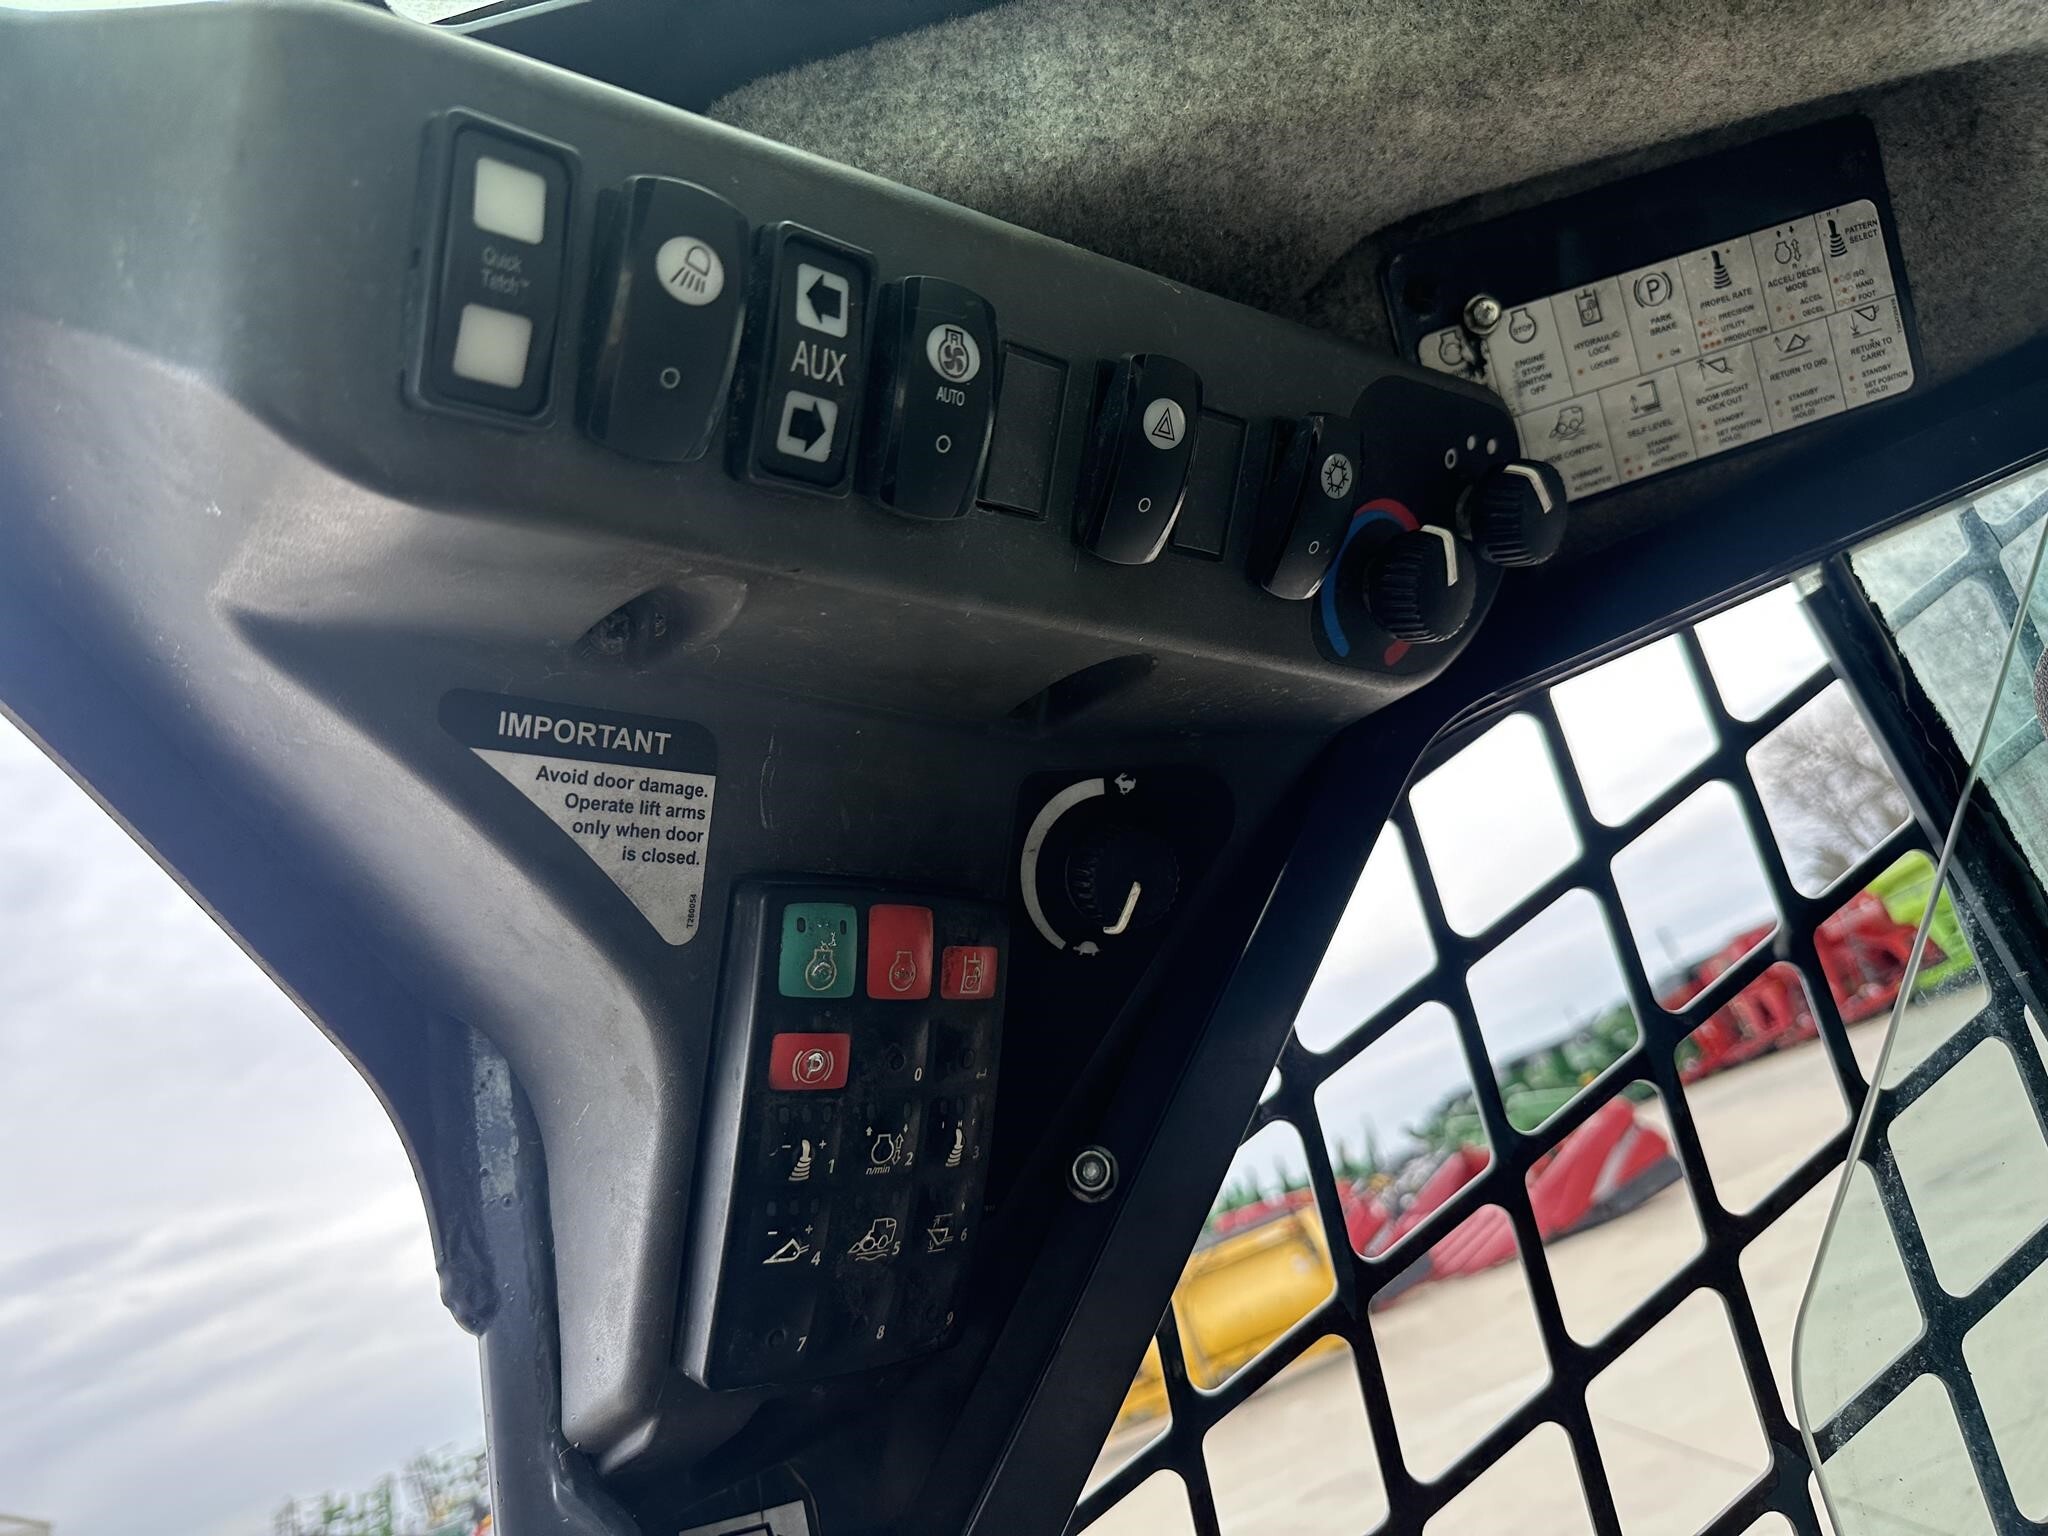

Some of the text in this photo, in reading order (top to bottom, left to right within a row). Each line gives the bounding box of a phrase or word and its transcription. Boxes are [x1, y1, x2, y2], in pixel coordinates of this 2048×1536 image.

[1845, 219, 1878, 235] PATTERN
[1850, 229, 1877, 244] SELECT
[1796, 266, 1823, 279] DECEL
[1853, 268, 1865, 278] ISO
[1785, 281, 1808, 292] MODE
[1855, 278, 1874, 289] HAND
[1700, 288, 1752, 309] PROPEL RATE
[1800, 293, 1822, 305] ACCEL
[1858, 289, 1876, 300] FOOT
[1650, 313, 1672, 325] PARK
[1718, 305, 1754, 320] PRECISION
[1802, 305, 1824, 317] DECEL
[1649, 321, 1677, 336] BRAKE
[1720, 320, 1745, 333] UTILITY
[1724, 325, 1768, 342] PRODUCTION
[1574, 332, 1621, 350] HYDRAULIC
[1850, 336, 1892, 356] RETURN TO
[1588, 345, 1610, 357] LOCK
[1861, 349, 1886, 362] CARRY
[790, 340, 848, 386] AUX
[1770, 358, 1828, 381] RETURN TO DIG
[1861, 363, 1891, 378] STANDBY
[1864, 370, 1908, 389] SET POSITION
[935, 386, 965, 407] AUTO
[1530, 384, 1546, 396] OFF
[1695, 382, 1749, 406] BOOM HEIGHT
[1788, 387, 1819, 401] STANDBY
[1706, 395, 1742, 412] KICK OUT
[1790, 394, 1836, 413] SET POSITION
[1713, 411, 1744, 426] STANDBY
[1716, 418, 1762, 438] SET POSITION
[1564, 441, 1602, 459] CONTROL
[498, 710, 672, 755] IMPORTANT
[535, 765, 709, 800] Avoid door damage.
[565, 792, 706, 821] Operate lift arms
[572, 819, 705, 843] only when door
[622, 846, 701, 866] is closed.
[913, 1066, 923, 1082] 0
[904, 1151, 914, 1167] 2
[972, 1145, 980, 1159] 3
[828, 1159, 836, 1174] 1
[865, 1164, 891, 1176] n/min
[960, 1227, 968, 1242] 6
[892, 1241, 901, 1256] 5
[810, 1250, 822, 1267] 4
[945, 1311, 954, 1329] 9
[876, 1324, 886, 1340] 8
[796, 1335, 808, 1353] 7
